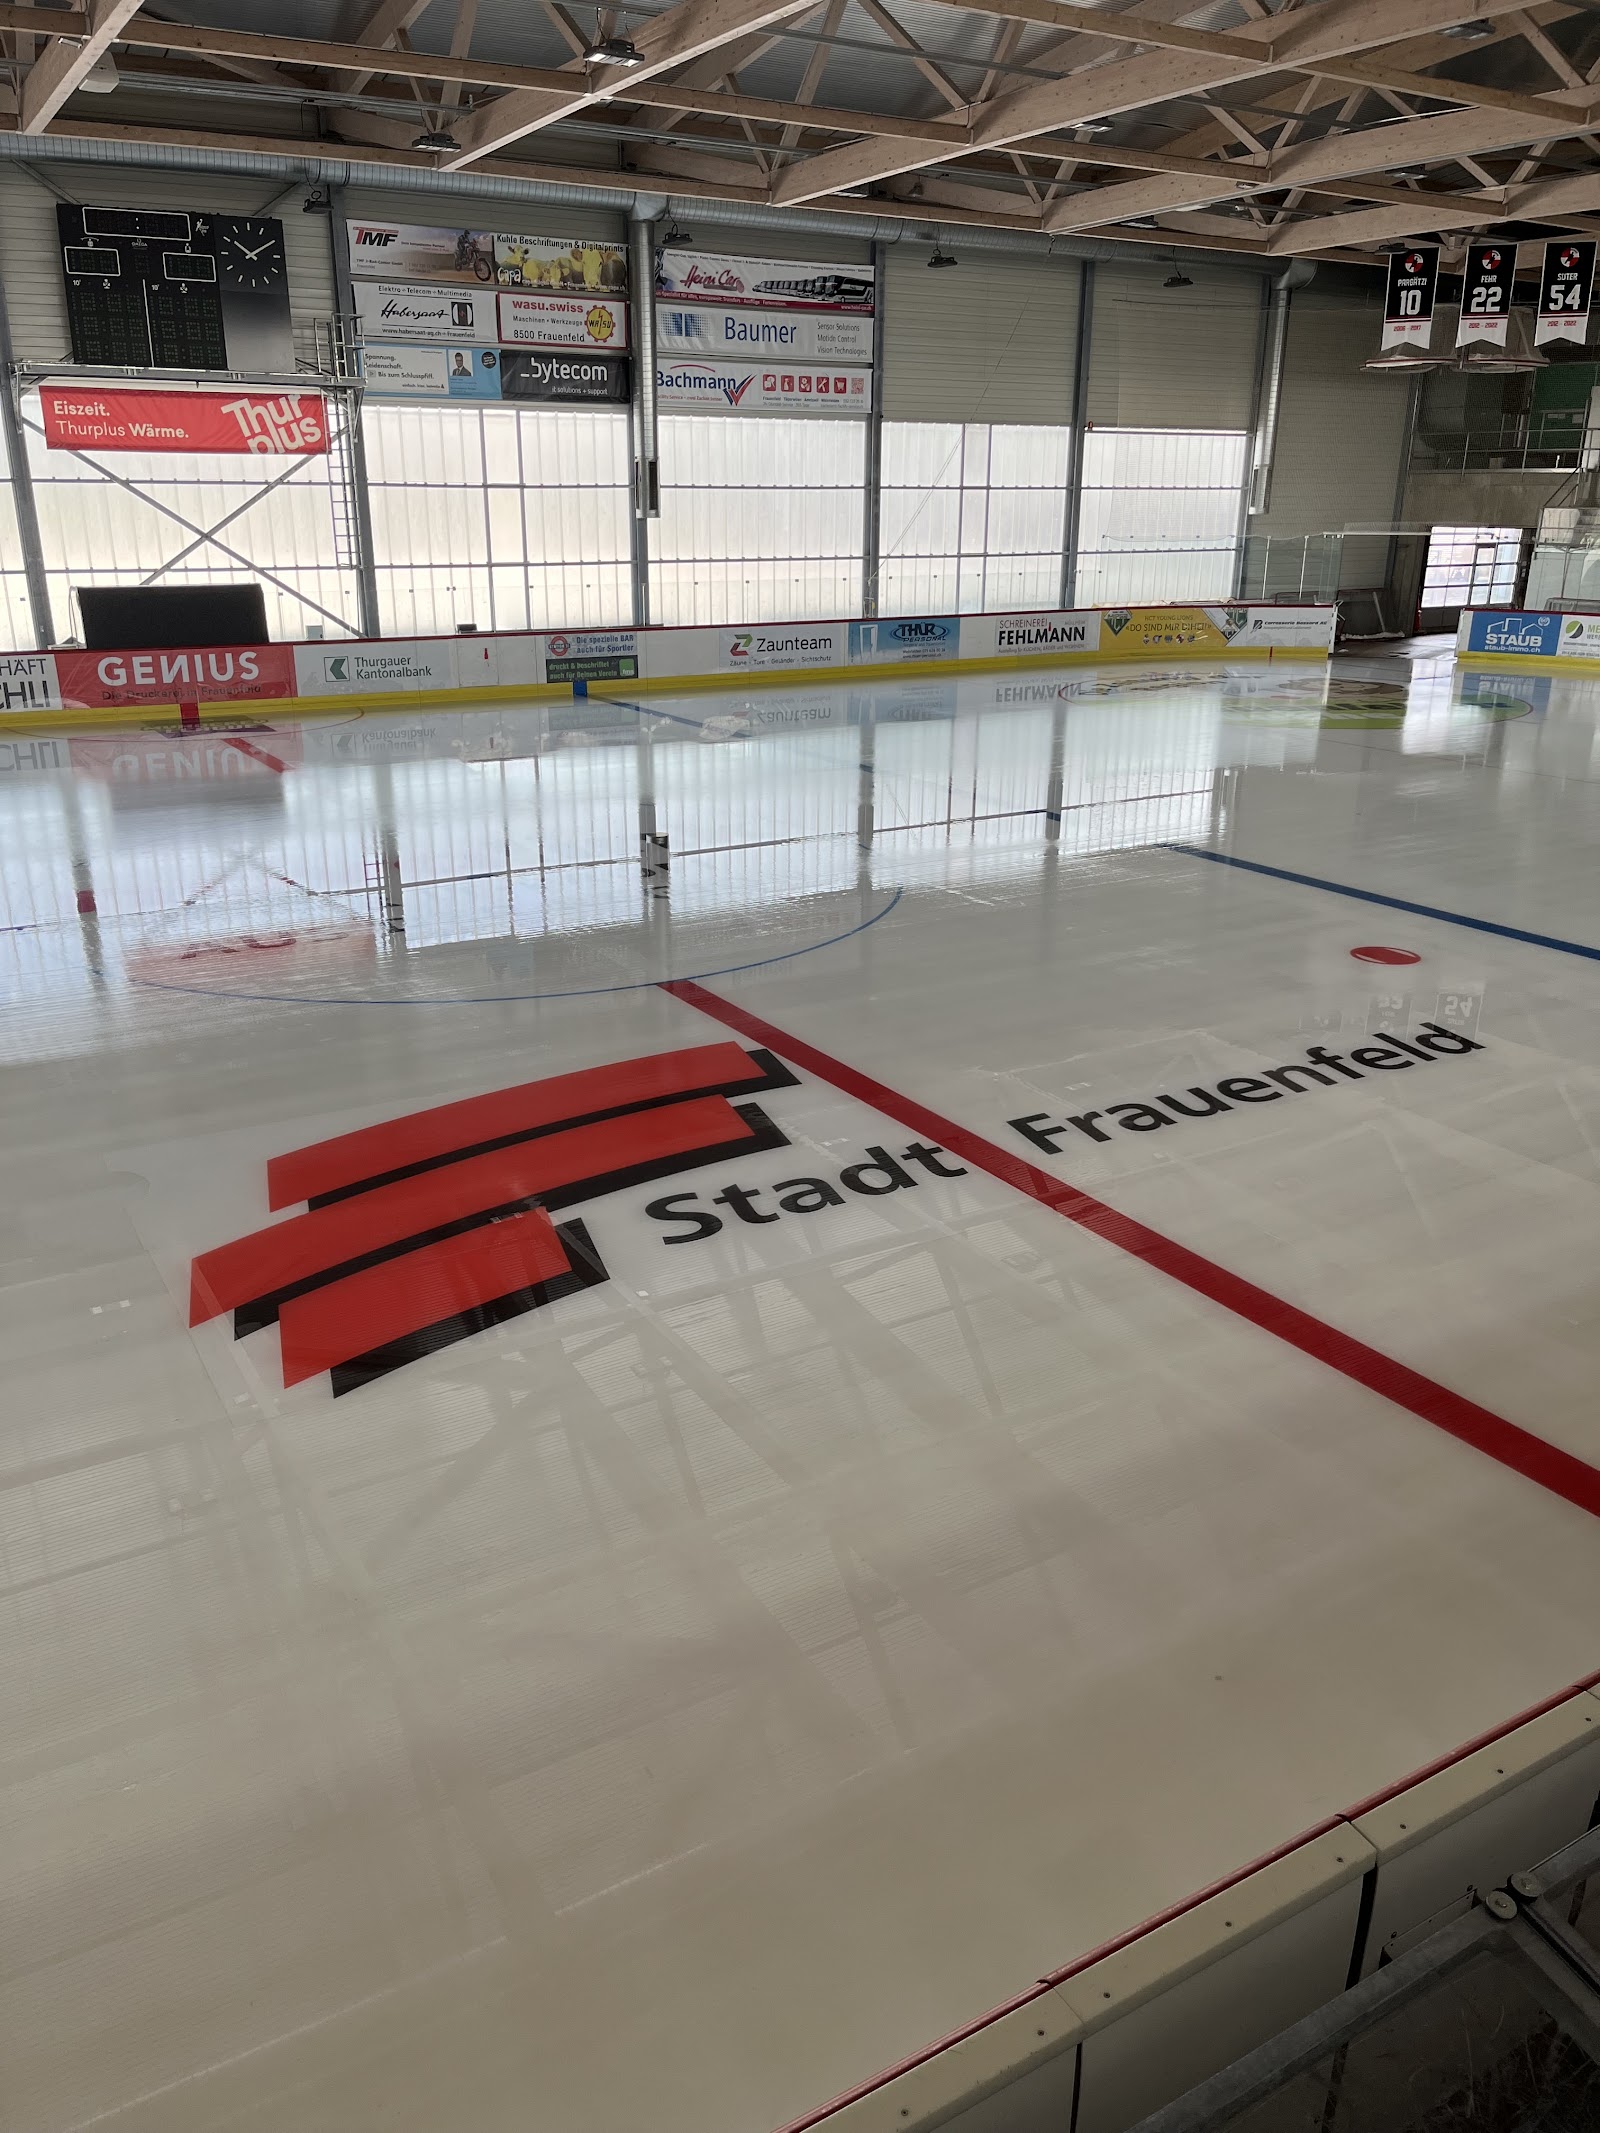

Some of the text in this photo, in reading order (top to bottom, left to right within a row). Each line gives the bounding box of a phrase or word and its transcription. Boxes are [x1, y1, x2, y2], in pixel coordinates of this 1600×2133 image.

[353, 226, 399, 247] TMF
[519, 236, 573, 250] Beschriftungen
[574, 241, 580, 249] &
[581, 241, 624, 253] Digitalprints
[680, 265, 740, 289] Heini Car
[1481, 275, 1497, 283] FEHR
[1557, 272, 1578, 281] SUTER
[378, 285, 473, 298] Elektro Telecom Multimedia
[1549, 284, 1581, 311] 54
[512, 300, 584, 313] wasu.swiss
[1400, 290, 1421, 315] 10
[1470, 286, 1502, 313] 22
[380, 299, 450, 320] Habersaat
[513, 315, 583, 326] Maschinen Werkzeuge
[817, 322, 860, 332] Sensor Solutions
[447, 330, 476, 338] Frauenfeld
[513, 329, 585, 342] 8500 Frauenfeld
[724, 317, 797, 344] Baumer
[817, 334, 857, 343] Motion Control
[365, 353, 397, 362] Spannung.
[817, 346, 867, 356] Vision Technologies
[657, 370, 736, 390] Bachmann
[557, 386, 582, 394] solutions
[587, 388, 608, 396] support
[53, 400, 110, 417] Eiszeit.
[220, 394, 302, 438] Thur
[55, 420, 190, 440] Thurplus Wärme.
[246, 415, 322, 455] plus
[999, 618, 1048, 629] SCHREINEREI
[1143, 622, 1162, 632] SIND
[1164, 622, 1179, 631] MIR
[576, 634, 634, 645] Die spezielle BAR
[998, 626, 1085, 646] FEHLMANN
[1485, 633, 1542, 647] STAUB
[576, 646, 593, 654] auch
[596, 645, 605, 653] für
[607, 645, 634, 653] Sportler
[757, 637, 832, 653] Zaunteam
[1484, 645, 1540, 653] staub-immo.ch
[354, 656, 412, 669] Thurgauer
[356, 665, 432, 680] Kantonalbank
[0, 680, 51, 710] HLI
[644, 1021, 1488, 1246] Stadt Frauenfeld
